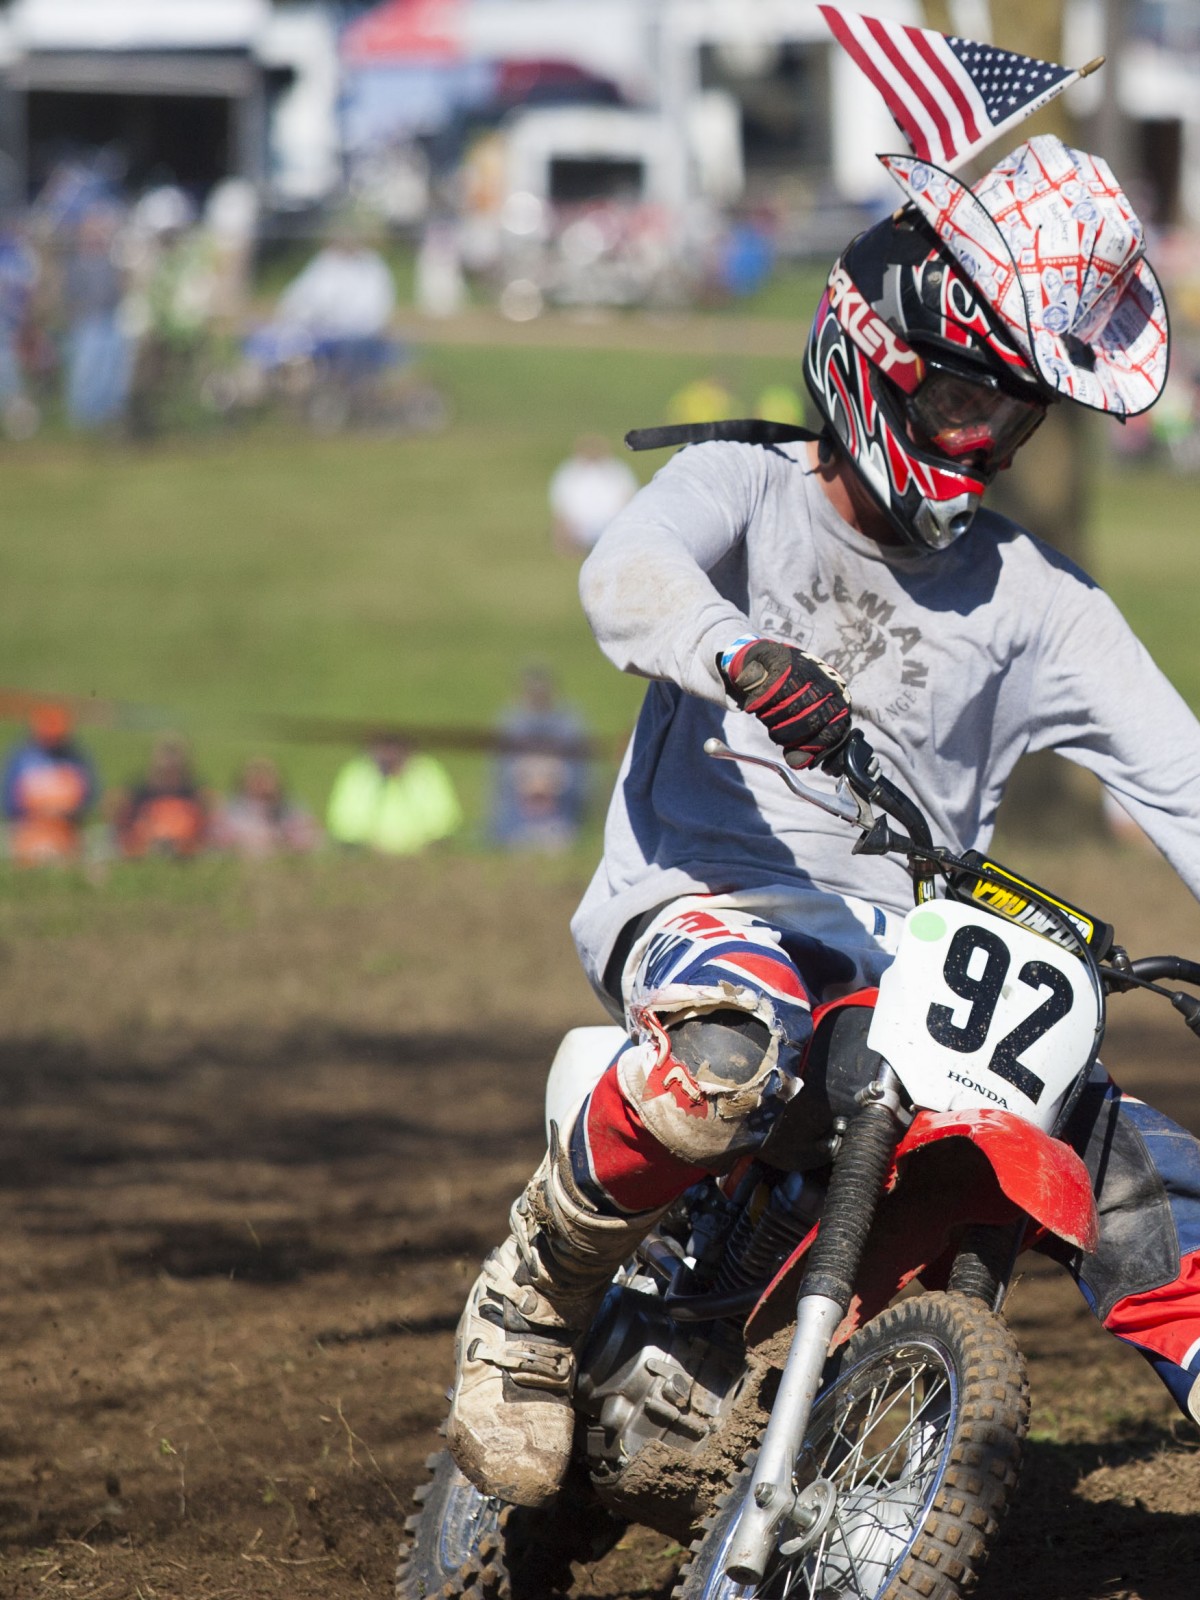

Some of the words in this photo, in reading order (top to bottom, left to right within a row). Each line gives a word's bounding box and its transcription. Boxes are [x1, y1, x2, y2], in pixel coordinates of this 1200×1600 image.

[793, 575, 930, 688] ICEMAN
[926, 924, 1074, 1106] 92
[947, 1069, 1009, 1110] HONDA
